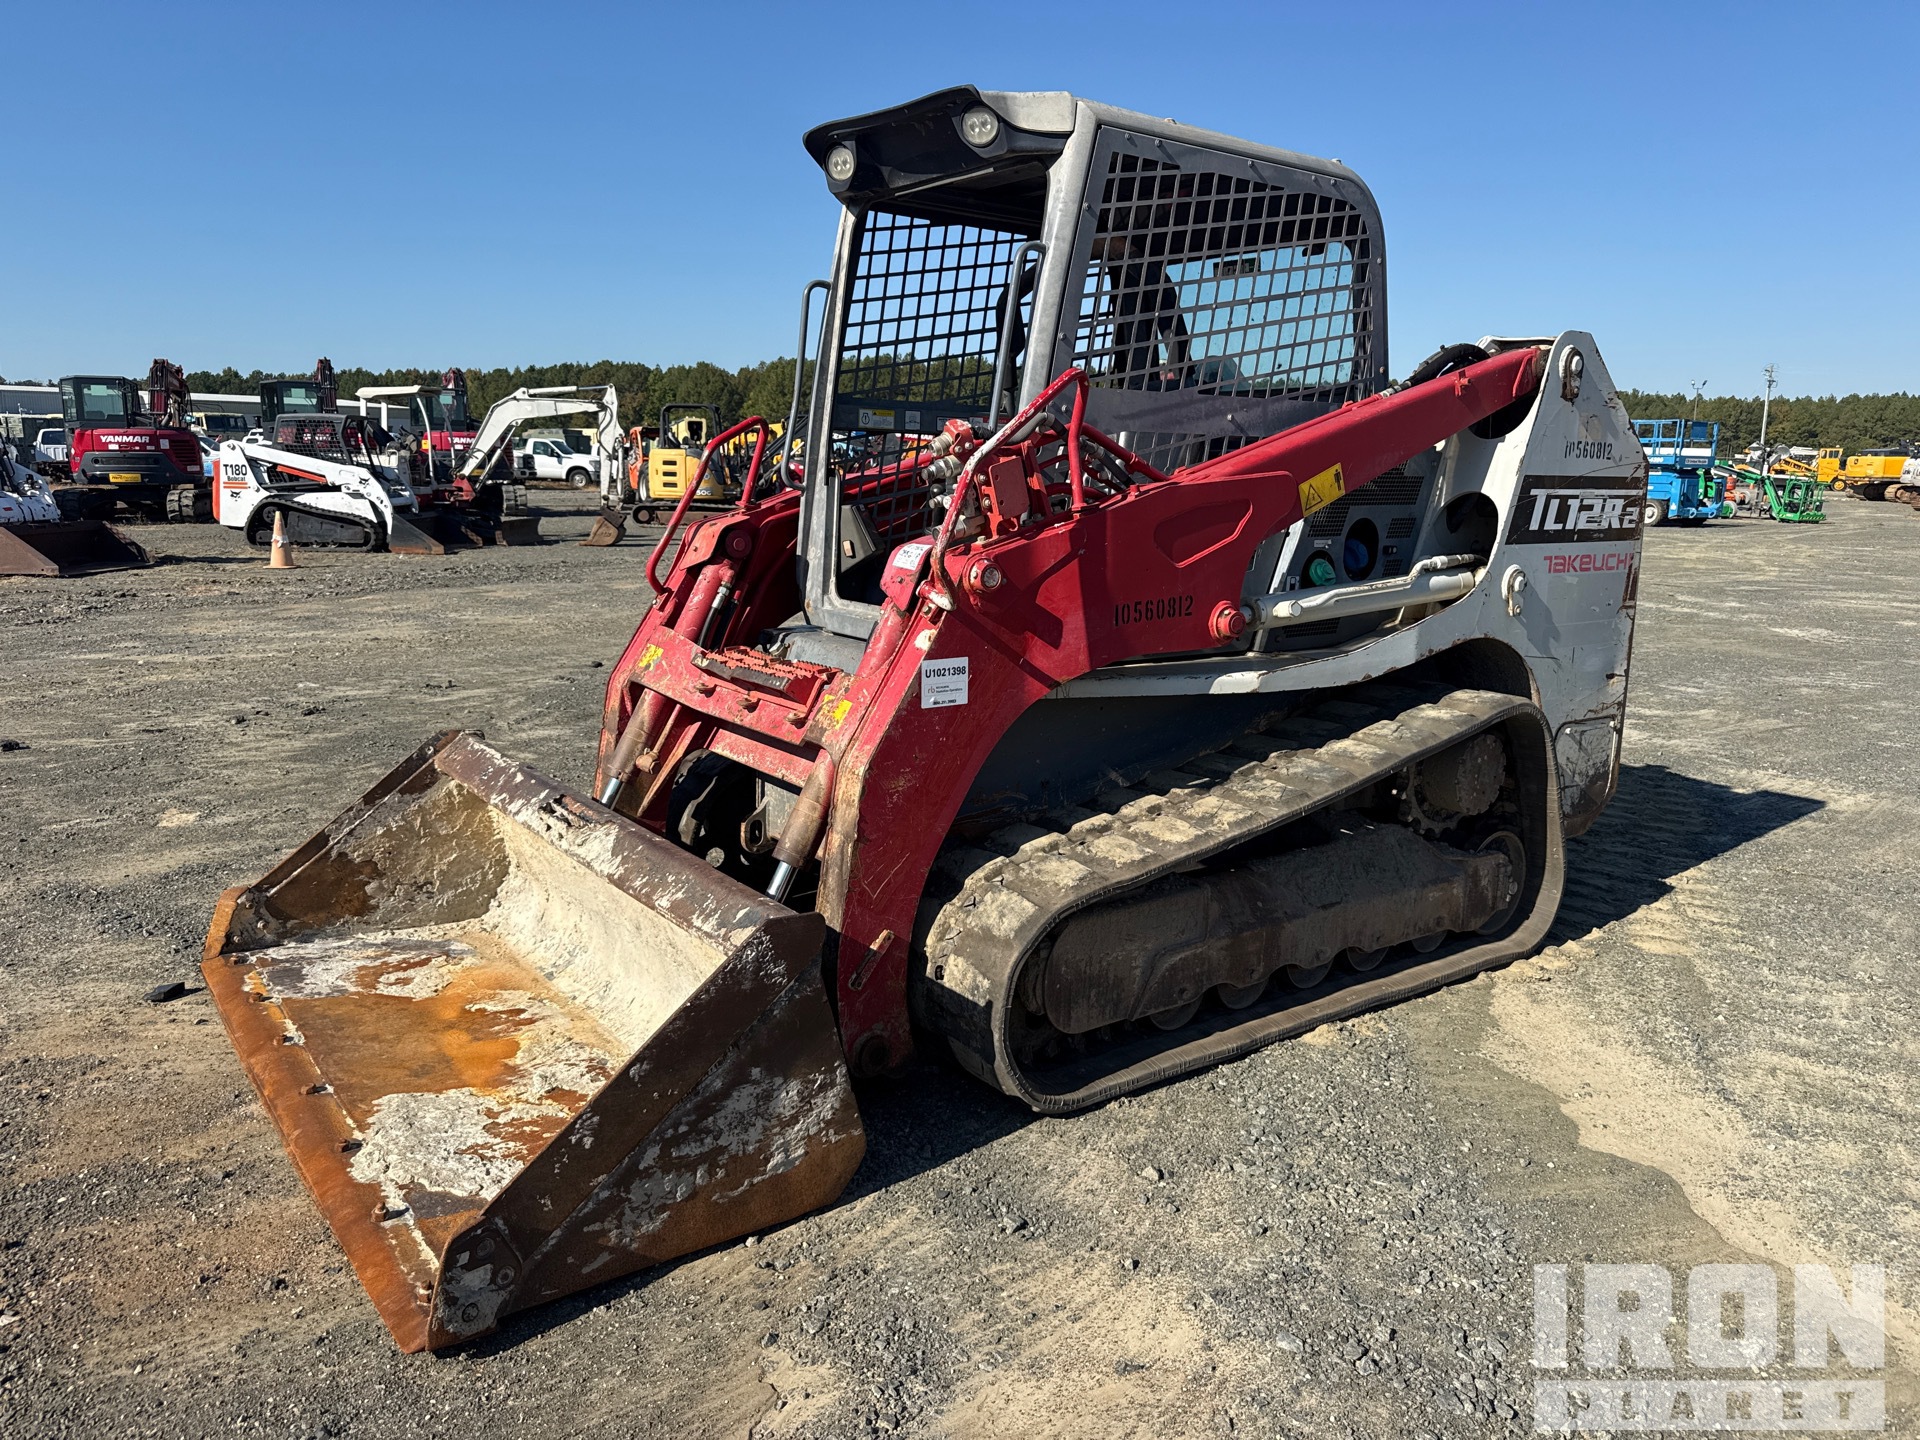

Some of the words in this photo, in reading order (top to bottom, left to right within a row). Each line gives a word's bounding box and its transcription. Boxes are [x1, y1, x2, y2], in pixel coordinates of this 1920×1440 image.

[100, 435, 150, 443] YANMAR
[447, 436, 476, 444] YANM
[223, 464, 248, 476] T180
[1528, 488, 1643, 531] TL12R2
[1113, 594, 1194, 627] 10560812
[925, 665, 967, 678] U1021398
